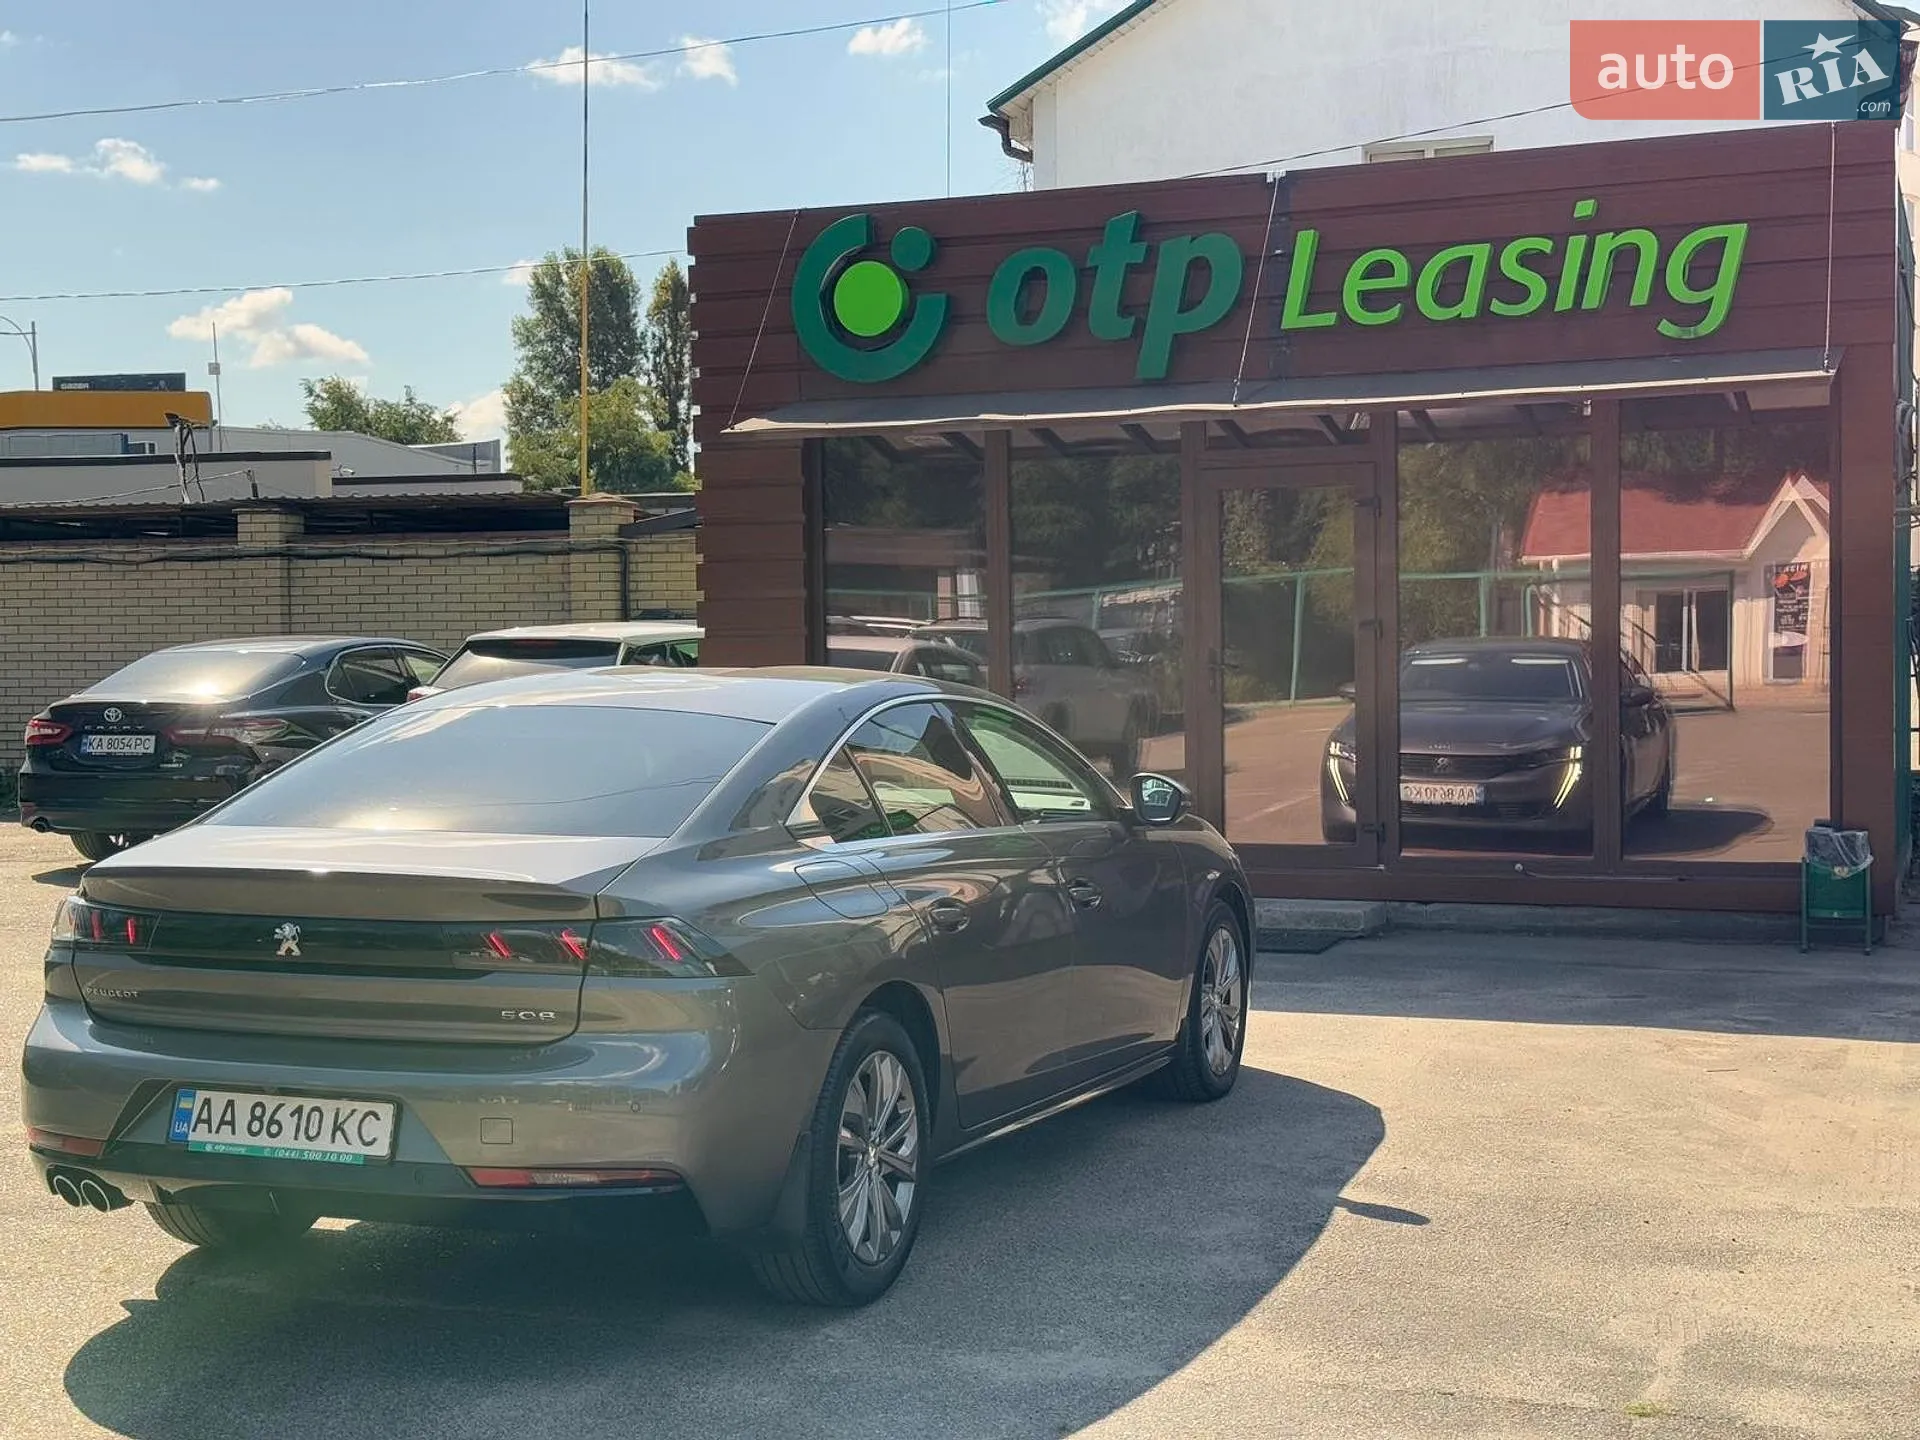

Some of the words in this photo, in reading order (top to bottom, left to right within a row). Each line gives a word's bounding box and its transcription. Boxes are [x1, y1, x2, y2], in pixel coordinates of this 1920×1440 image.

[985, 210, 1244, 380] otp
[1280, 198, 1749, 340] Leasing
[106, 738, 134, 751] 8054
[174, 1121, 189, 1134] UA
[191, 1097, 237, 1136] AA
[246, 1101, 325, 1143] 8610
[331, 1107, 382, 1147] KC
